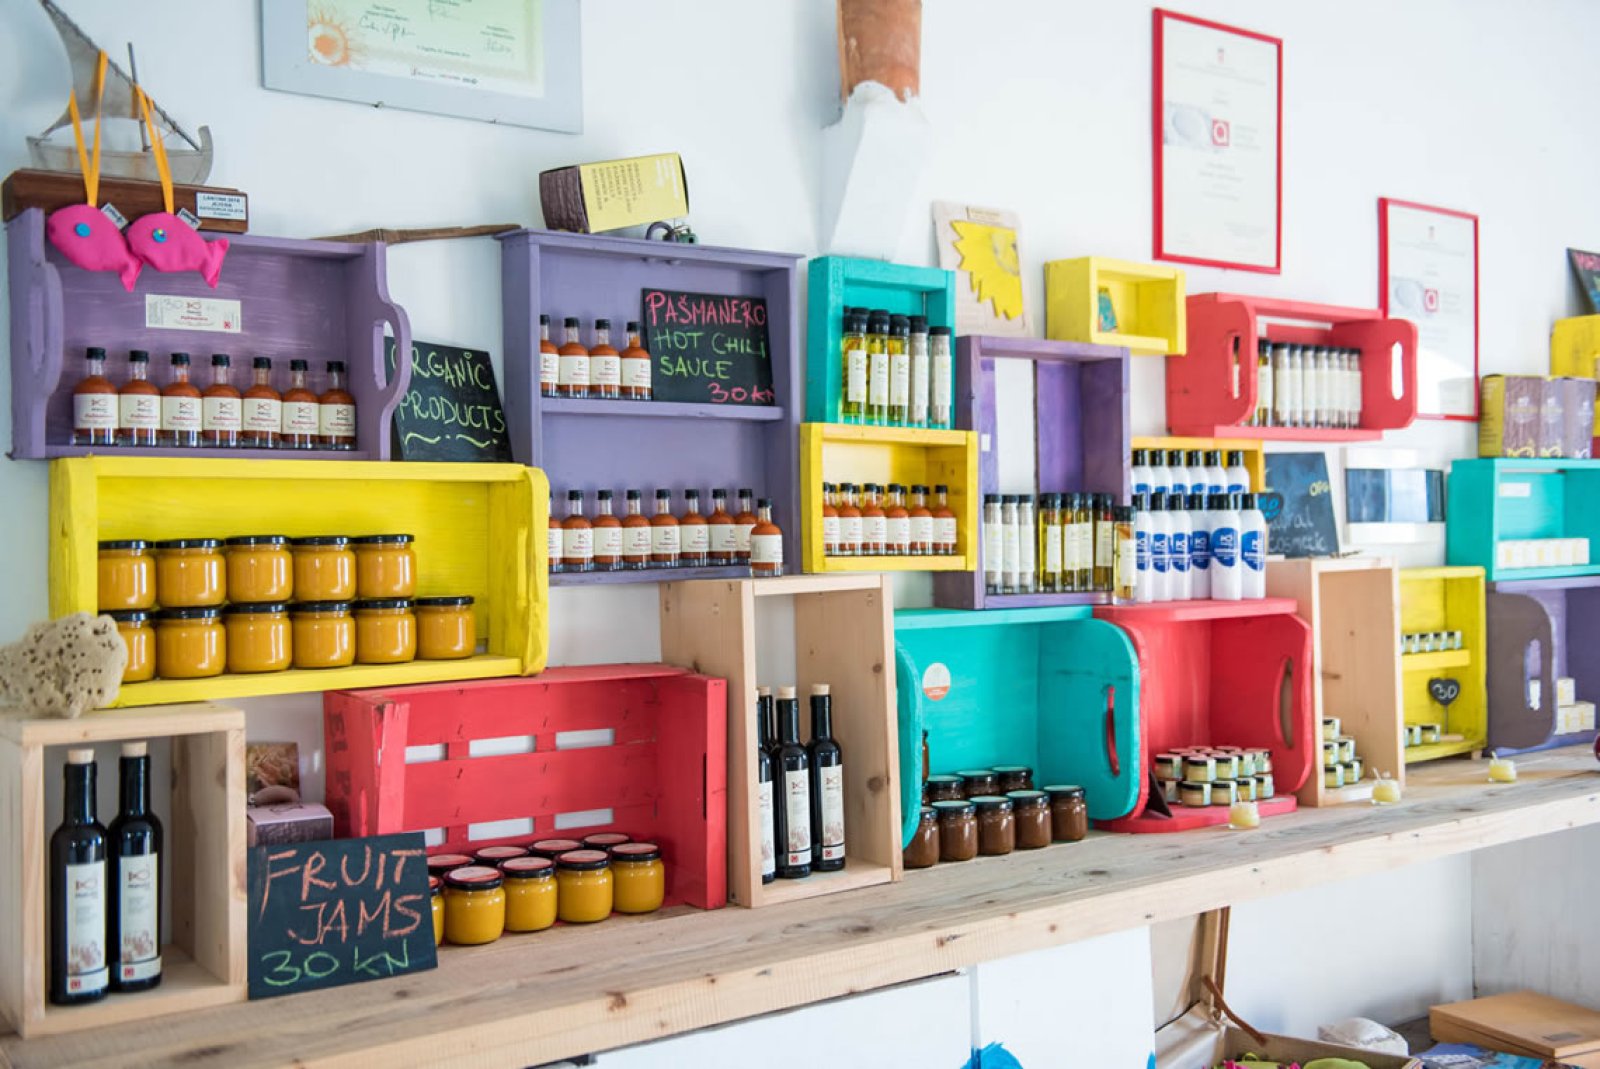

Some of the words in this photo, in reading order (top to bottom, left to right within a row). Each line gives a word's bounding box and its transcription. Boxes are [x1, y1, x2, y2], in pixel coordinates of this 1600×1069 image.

[645, 291, 766, 329] PAŠMANERO
[653, 328, 704, 351] HOT
[659, 354, 733, 379] SAUCE
[400, 390, 505, 434] PRODUCTS
[1432, 683, 1458, 699] 30
[259, 844, 425, 922] FRUIT
[286, 890, 424, 945] JAMS
[261, 950, 340, 986] 30
